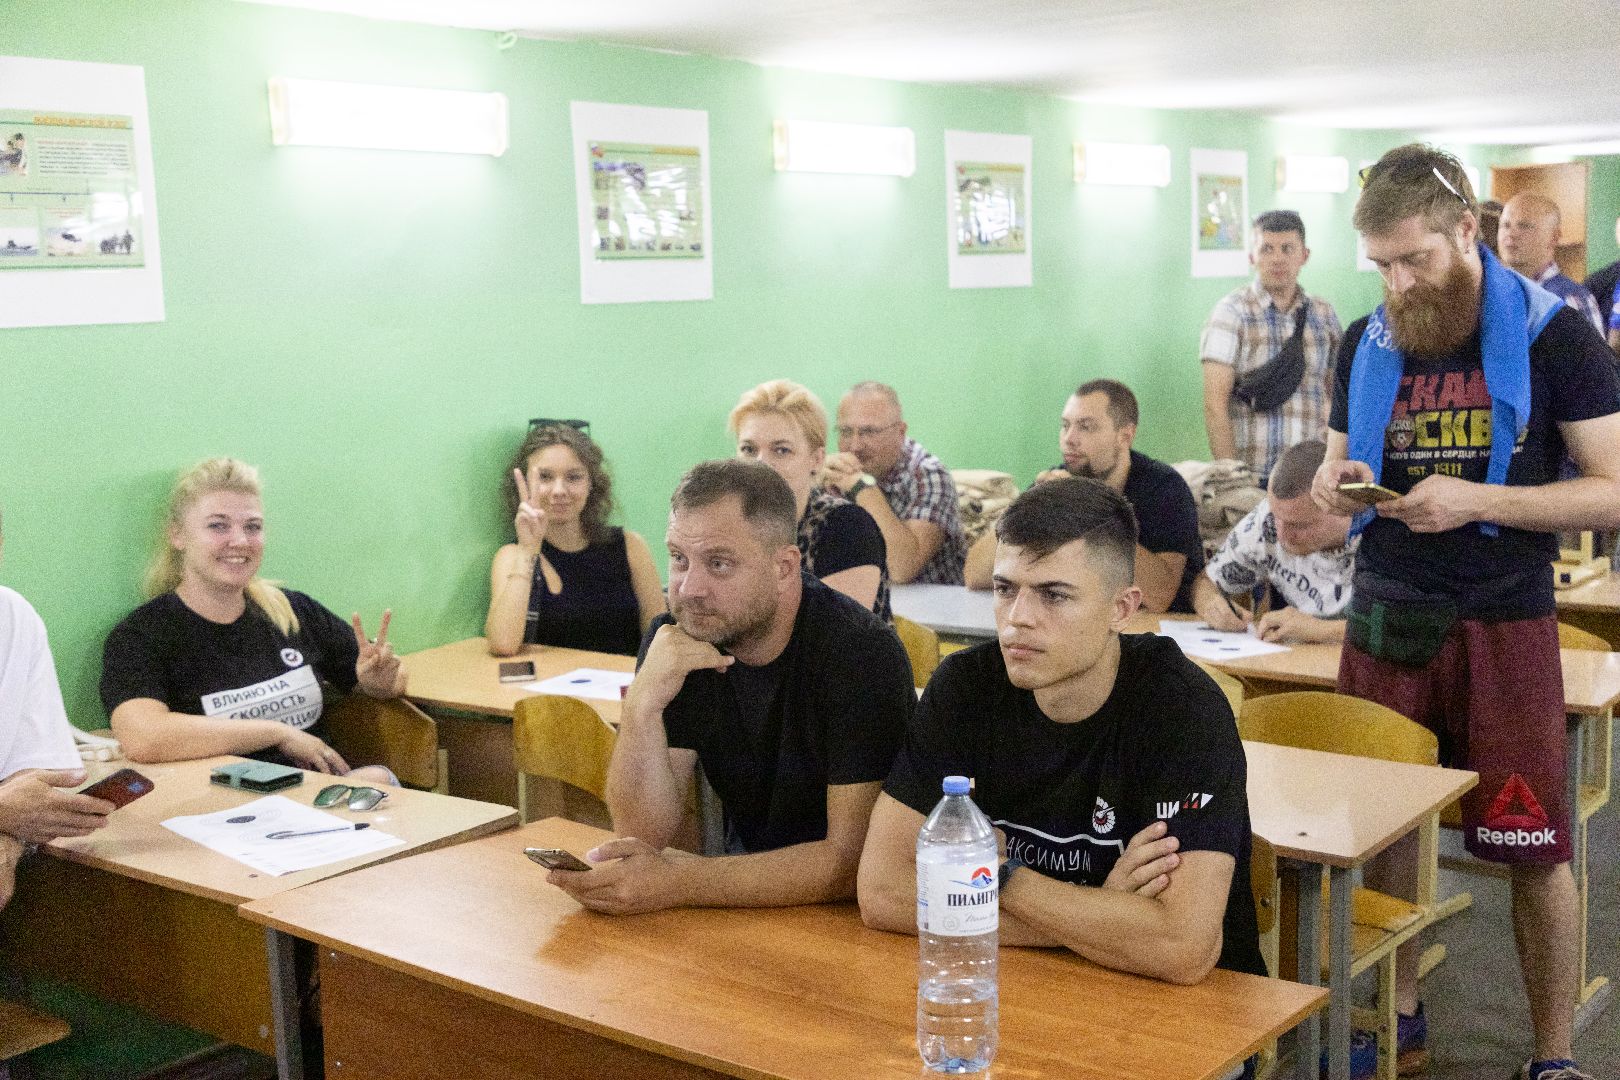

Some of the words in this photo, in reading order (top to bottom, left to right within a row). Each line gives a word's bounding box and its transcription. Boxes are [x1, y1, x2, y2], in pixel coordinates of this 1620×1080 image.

[1410, 450, 1432, 459] ОДИН
[1433, 450, 1441, 458] В
[1442, 449, 1477, 459] СЕРДЦЕ
[212, 687, 266, 709] ВЛИЯЮ
[268, 680, 290, 693] НА
[1477, 827, 1556, 846] Reebok
